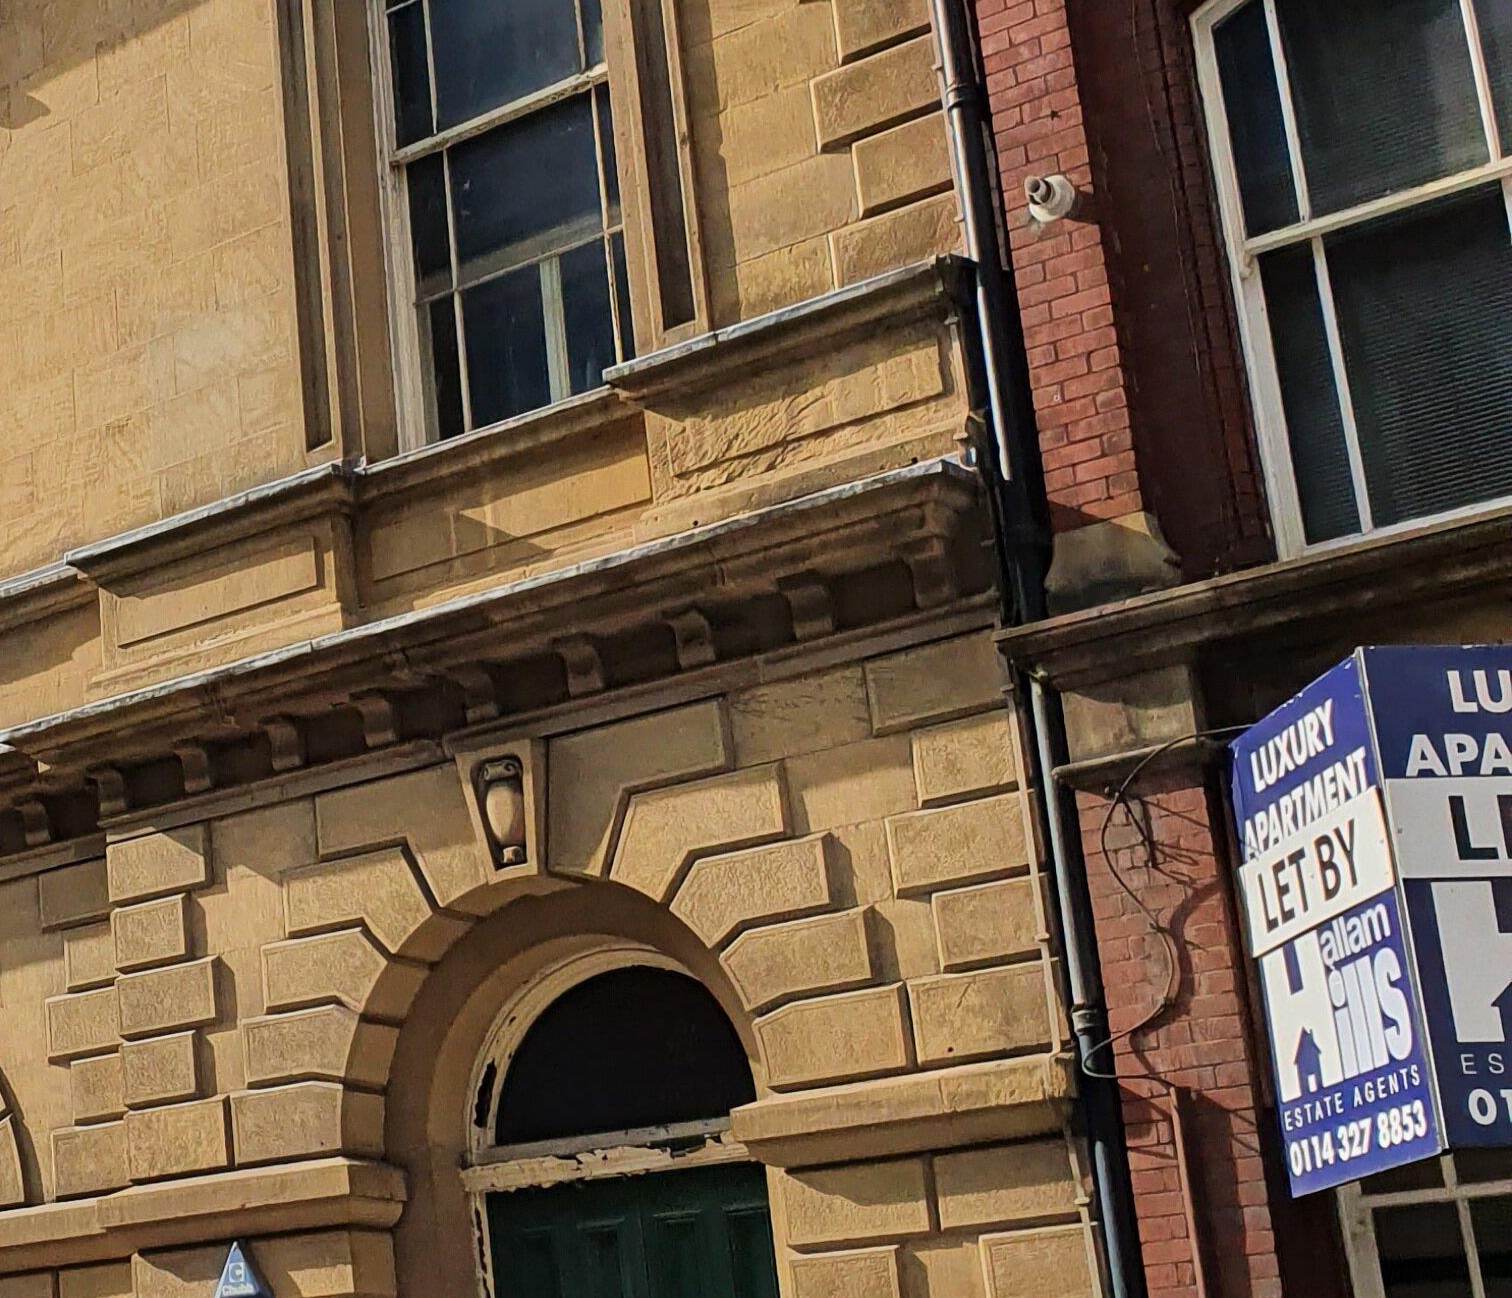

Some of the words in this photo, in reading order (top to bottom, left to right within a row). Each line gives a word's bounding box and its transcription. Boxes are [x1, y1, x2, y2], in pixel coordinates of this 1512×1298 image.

[1250, 697, 1335, 794] LUXURY
[1244, 745, 1368, 862] APARTMENT
[1257, 846, 1309, 934] LET
[1314, 817, 1358, 901] BY
[1284, 1092, 1344, 1132] ESTATE
[1353, 1064, 1421, 1108] AGENTS
[1290, 1131, 1335, 1177] 0114
[1337, 1117, 1373, 1162] 327
[1377, 1099, 1427, 1149] 8853
